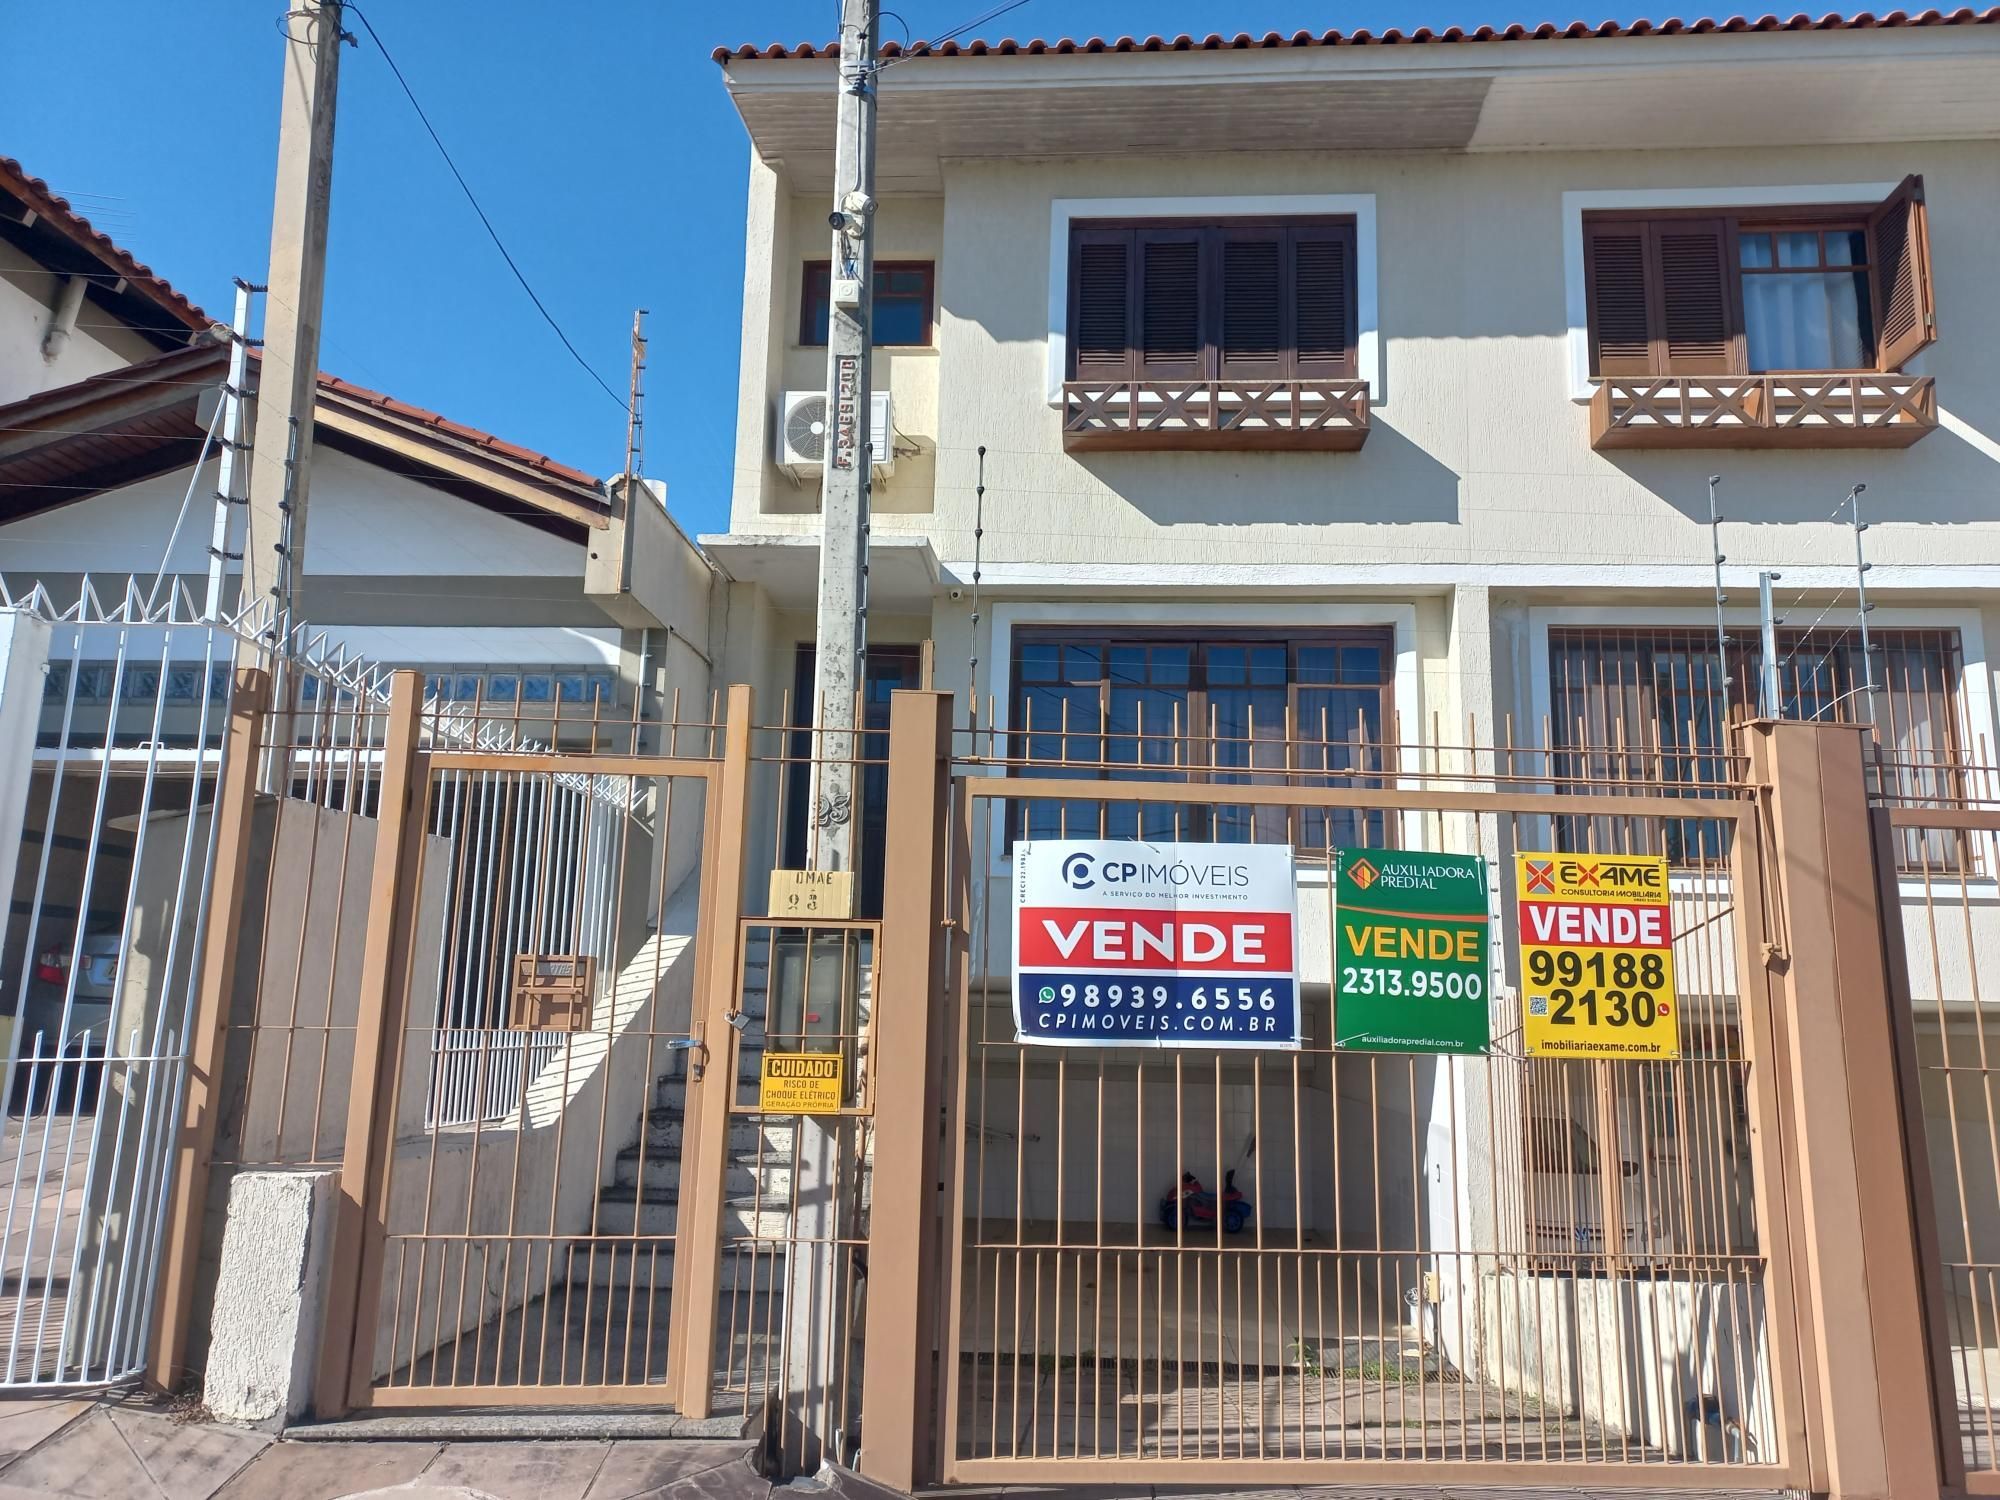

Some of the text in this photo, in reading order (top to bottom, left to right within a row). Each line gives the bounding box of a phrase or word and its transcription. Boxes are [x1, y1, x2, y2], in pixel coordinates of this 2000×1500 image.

[1381, 864, 1475, 879] AUXILIADORA
[1559, 861, 1661, 888] EXAME
[1381, 876, 1437, 890] PREDIAL
[1561, 888, 1615, 897] CONSULTORIA
[1528, 905, 1663, 945] VENDE
[1041, 919, 1267, 964] VENDE
[1345, 925, 1480, 963] VENDE
[1529, 950, 1665, 990] 99188
[1342, 967, 1482, 1000] 2313.9500
[1060, 984, 1276, 1011] 98939.6556
[1550, 988, 1656, 1028] 2130
[1038, 1013, 1276, 1032] CPIMOVEIS.COM.BR
[1361, 1035, 1464, 1048] auxiliadorapredial.com.br
[1541, 1039, 1661, 1053] imobiliariaexame.com.br
[771, 1060, 834, 1078] CUIDADO
[783, 1079, 820, 1089] RISCO DE
[765, 1090, 798, 1100] CHOQUE
